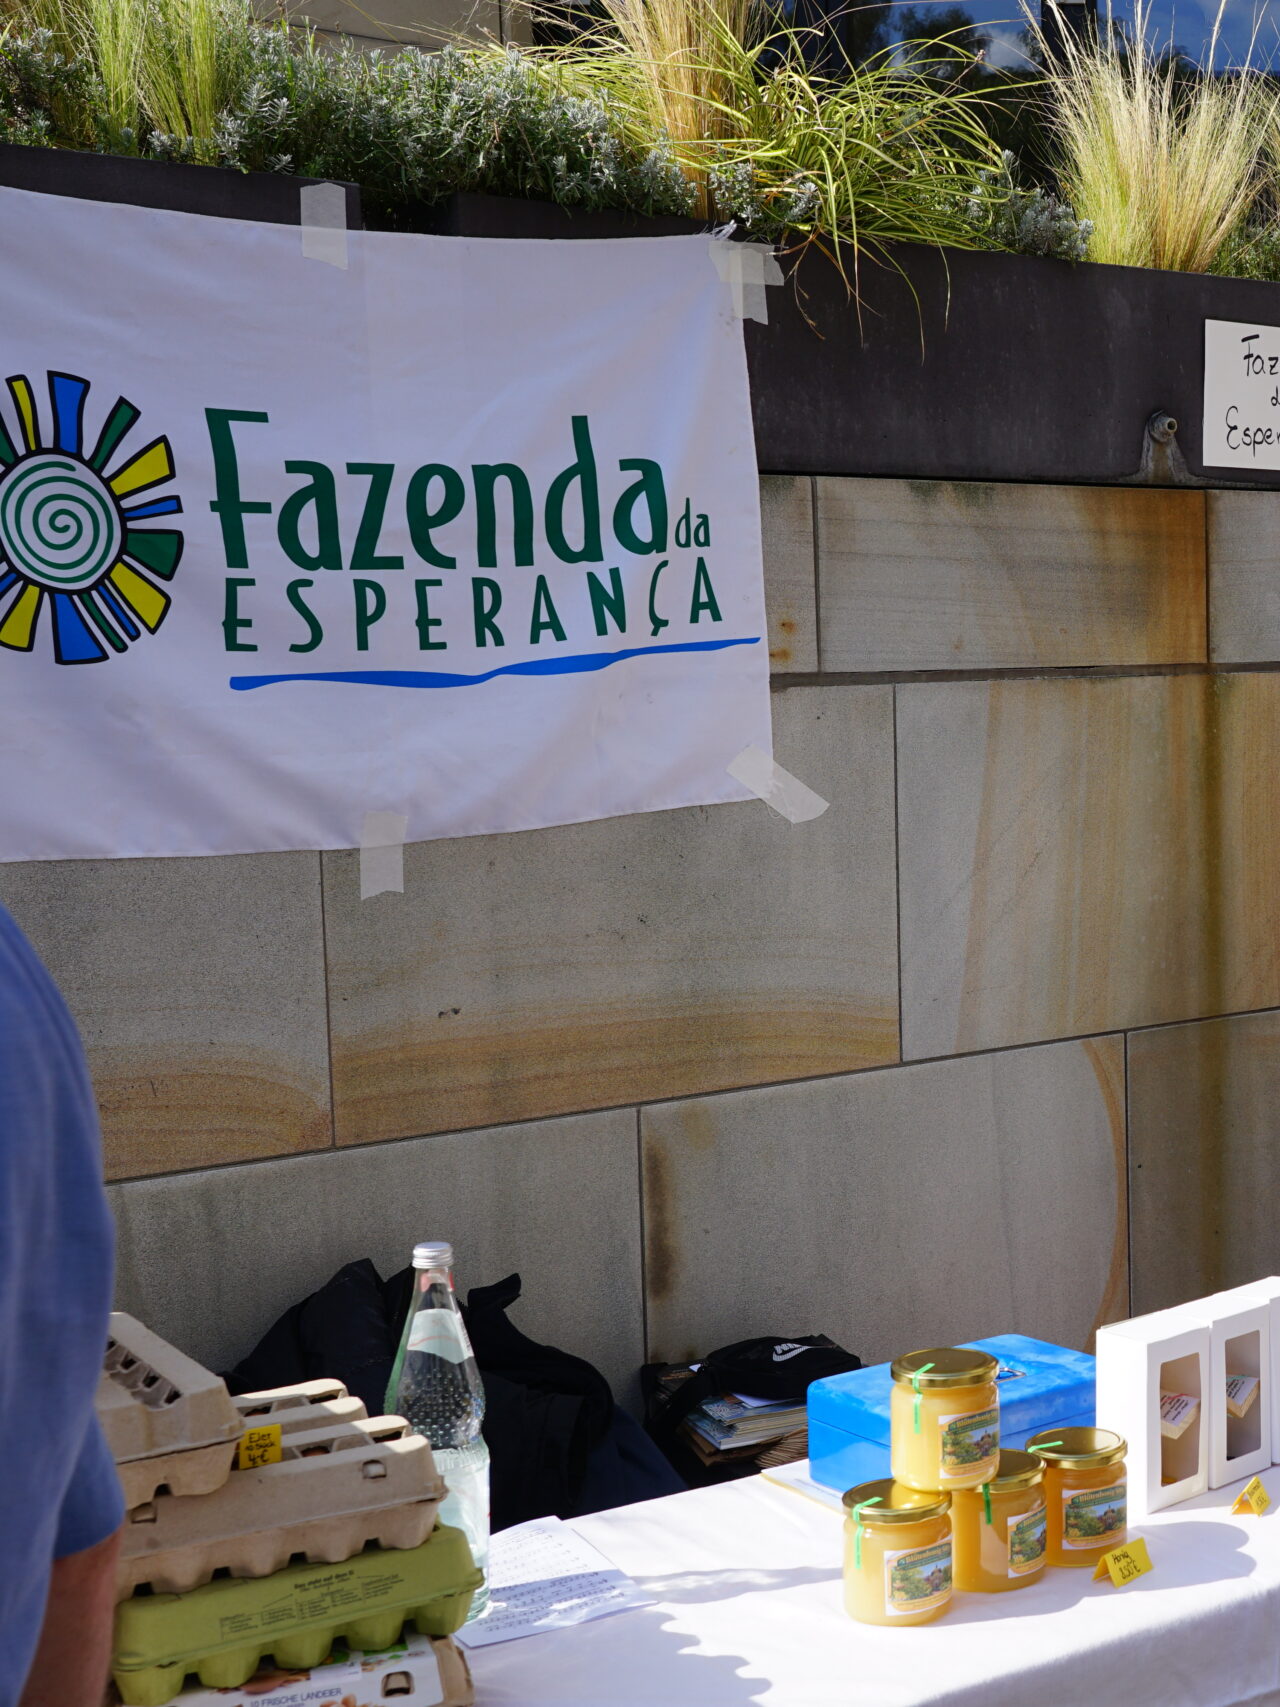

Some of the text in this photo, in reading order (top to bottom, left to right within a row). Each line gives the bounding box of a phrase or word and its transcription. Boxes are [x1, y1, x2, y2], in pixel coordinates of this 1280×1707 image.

[205, 407, 711, 571] Fazenda da
[222, 557, 723, 653] ESPERANÇA
[261, 1693, 298, 1707] FRISCHE
[300, 1687, 343, 1702] LANDEIER
